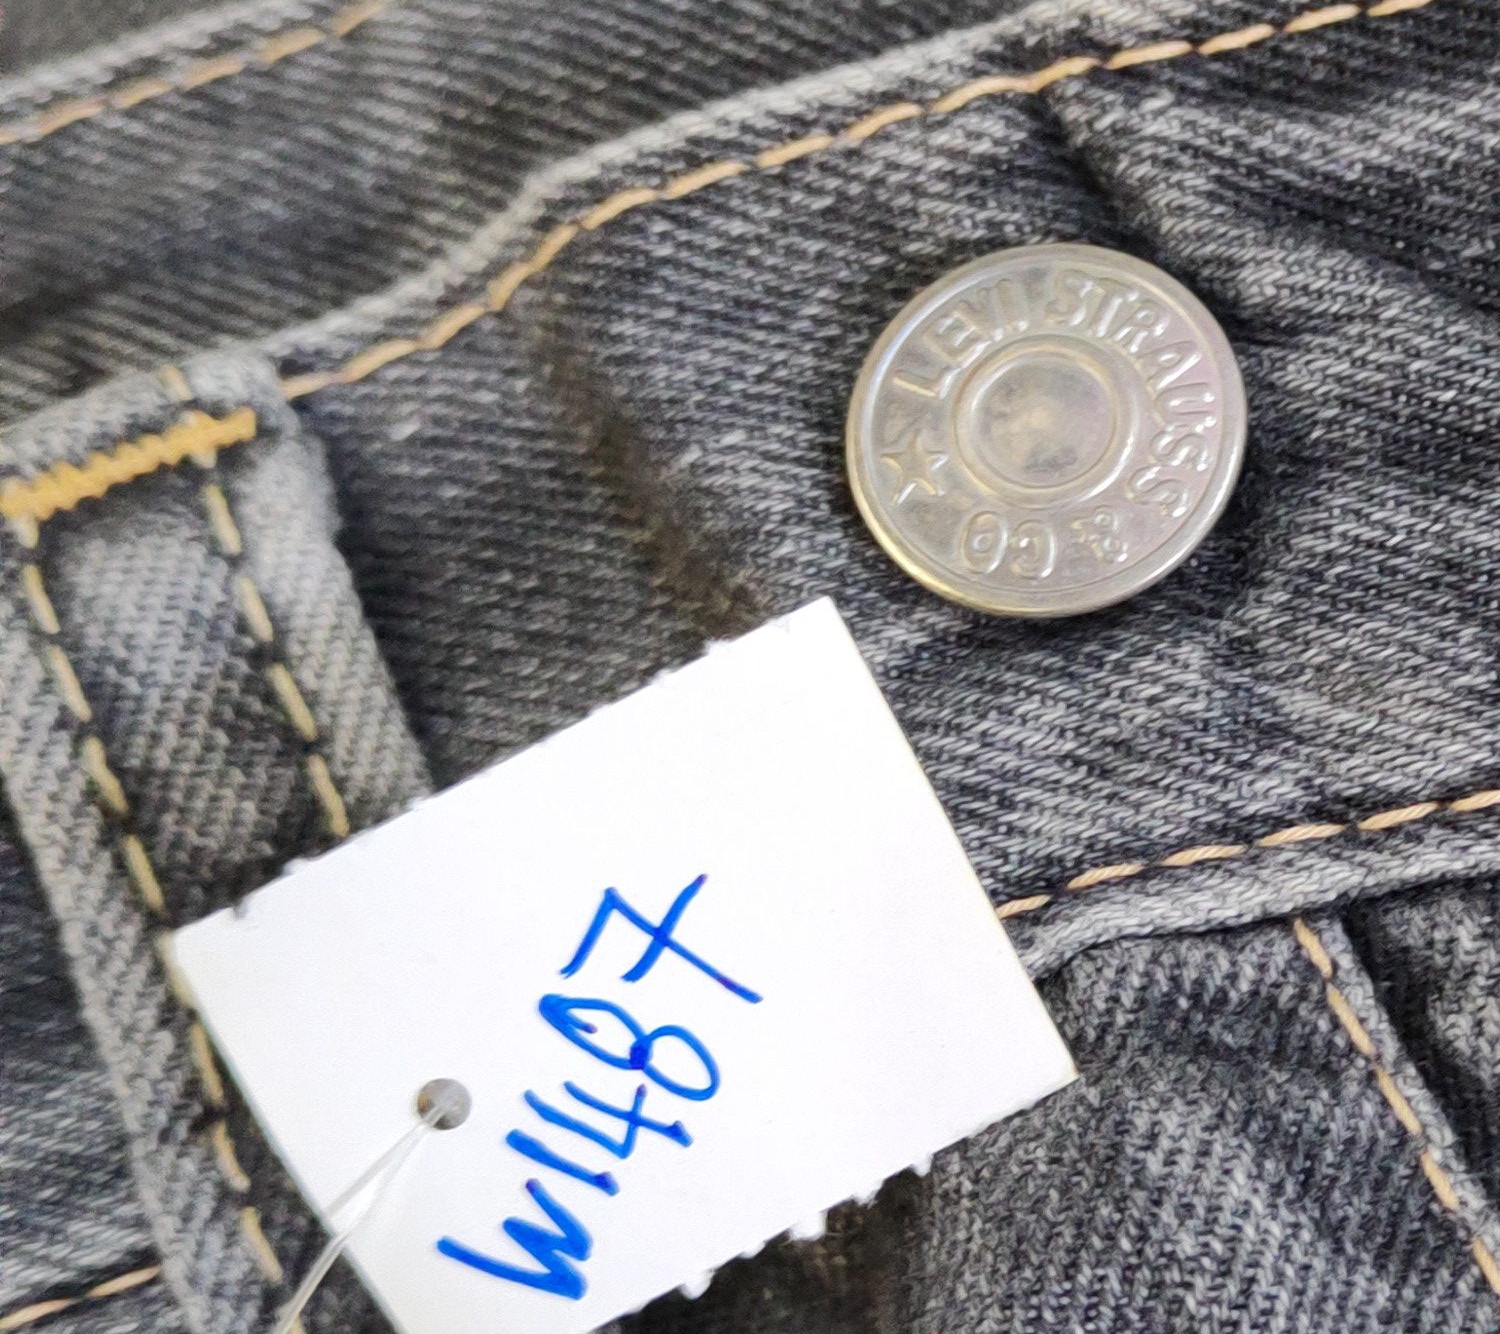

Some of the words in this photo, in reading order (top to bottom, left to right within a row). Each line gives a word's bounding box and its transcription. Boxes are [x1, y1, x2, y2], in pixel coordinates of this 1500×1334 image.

[892, 277, 1028, 399] LEVI
[1045, 268, 1219, 518] STRAUSS
[961, 510, 1058, 579] CO
[1071, 505, 1130, 564] &
[437, 873, 764, 1301] W1487
